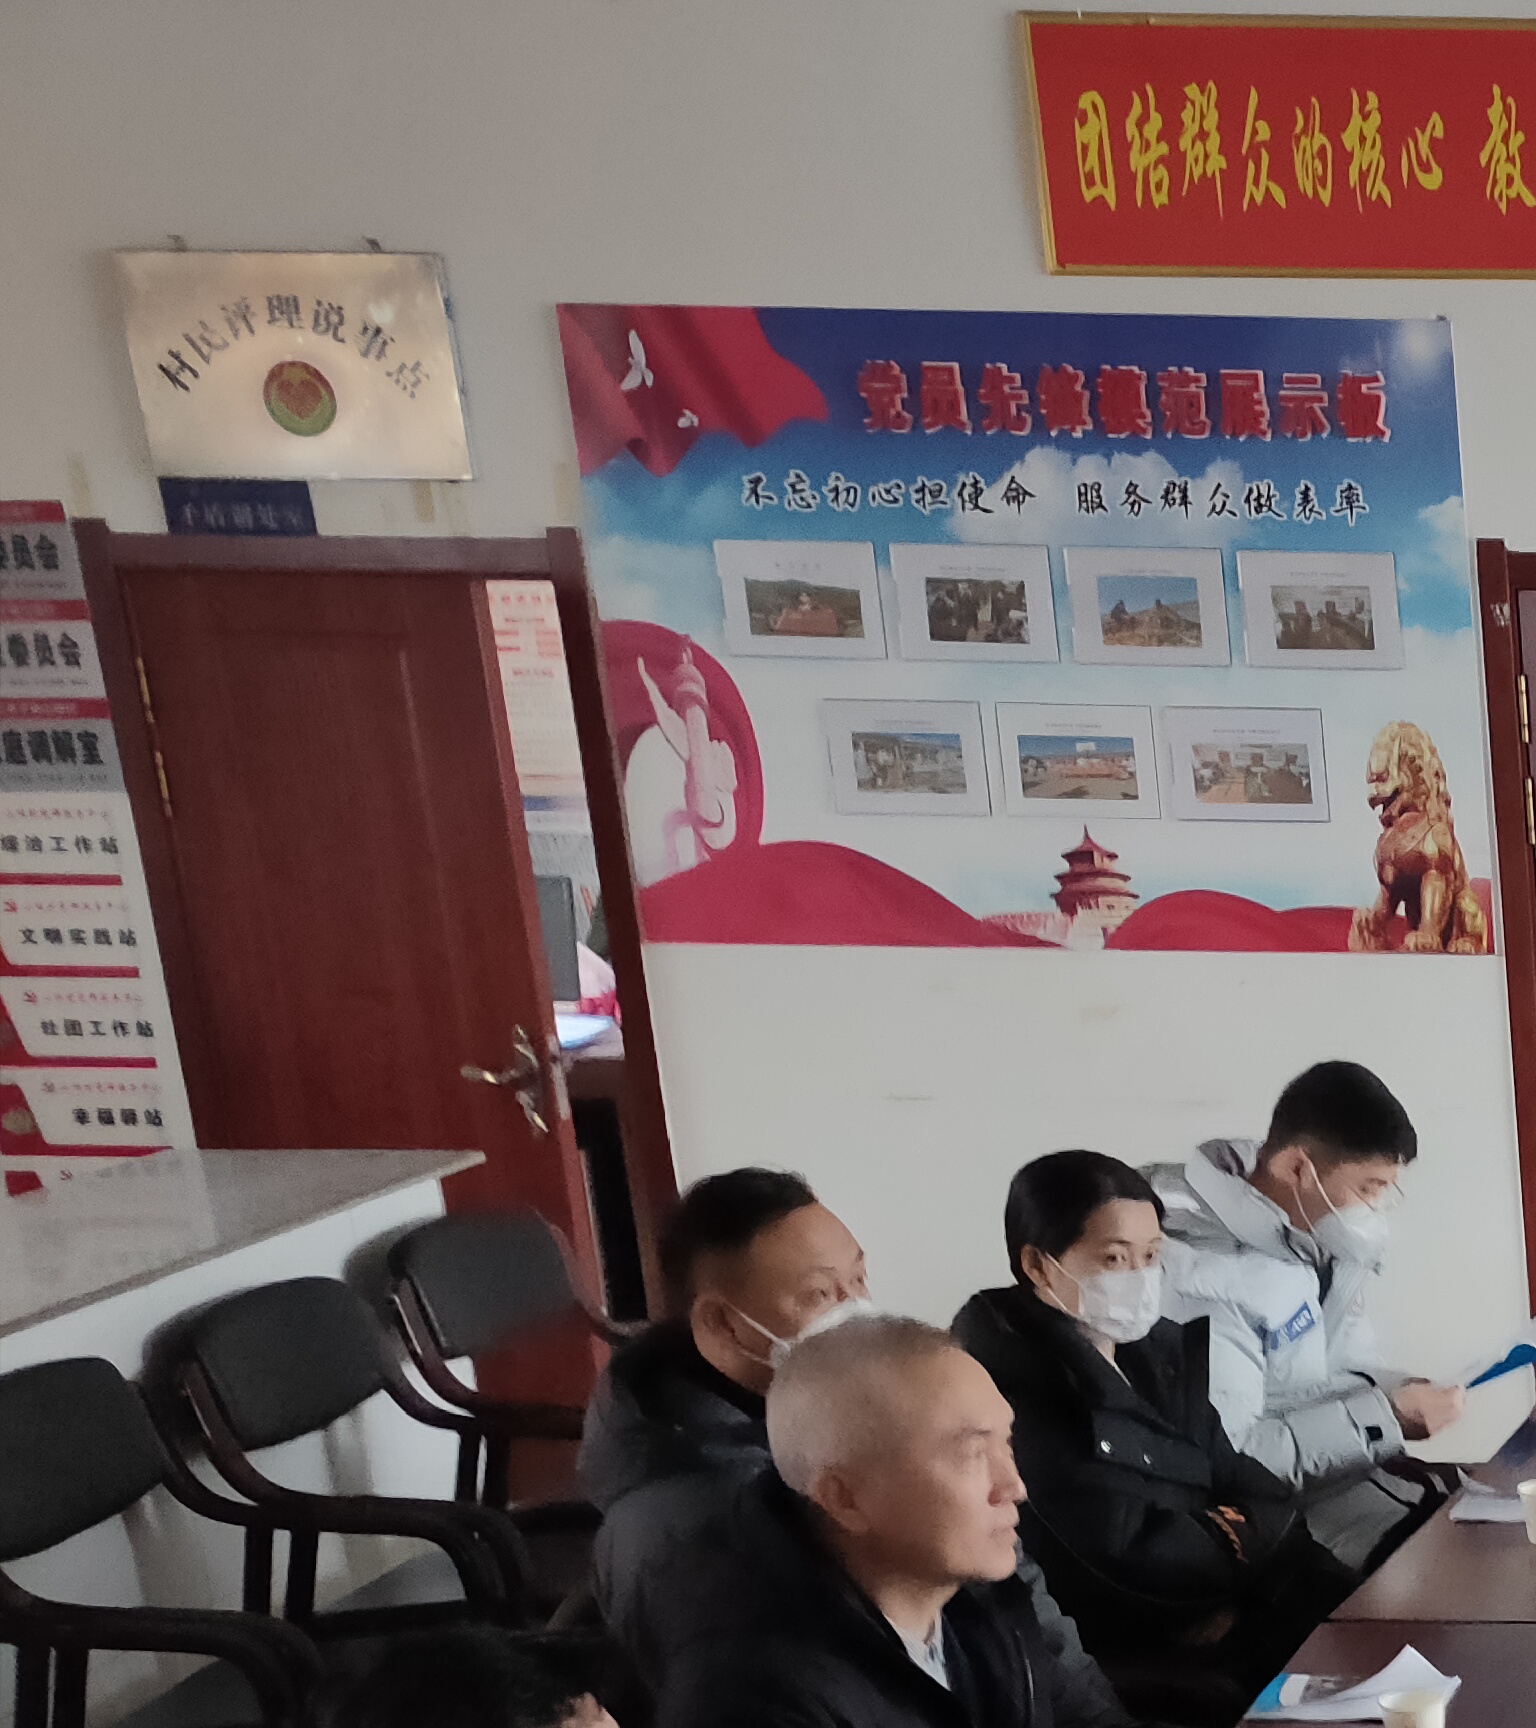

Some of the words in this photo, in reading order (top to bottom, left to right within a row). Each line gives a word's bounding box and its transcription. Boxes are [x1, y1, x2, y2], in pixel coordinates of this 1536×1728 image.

[1074, 79, 1445, 219] 团结群众的核心
[156, 294, 431, 400] 村民评理说事点
[856, 360, 1391, 443] 党员先锋模范展示板
[740, 470, 1038, 517] 不忘初心担使命
[1075, 480, 1371, 523] 服务群众做表率
